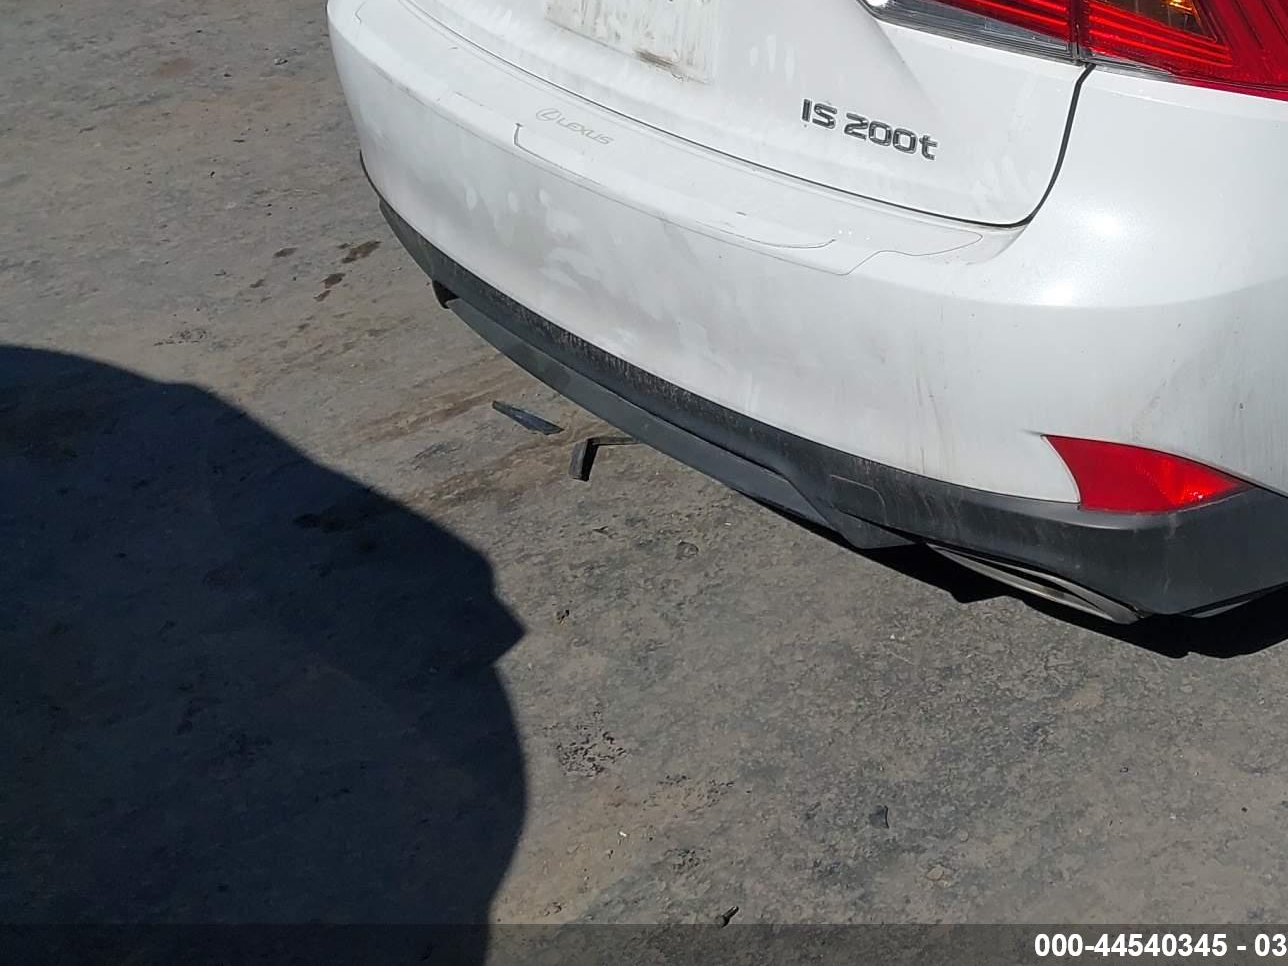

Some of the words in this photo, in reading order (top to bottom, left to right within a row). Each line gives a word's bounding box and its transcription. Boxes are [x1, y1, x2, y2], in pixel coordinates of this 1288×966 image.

[556, 117, 614, 145] LEXUS
[801, 98, 838, 130] IS
[843, 112, 938, 161] 200t
